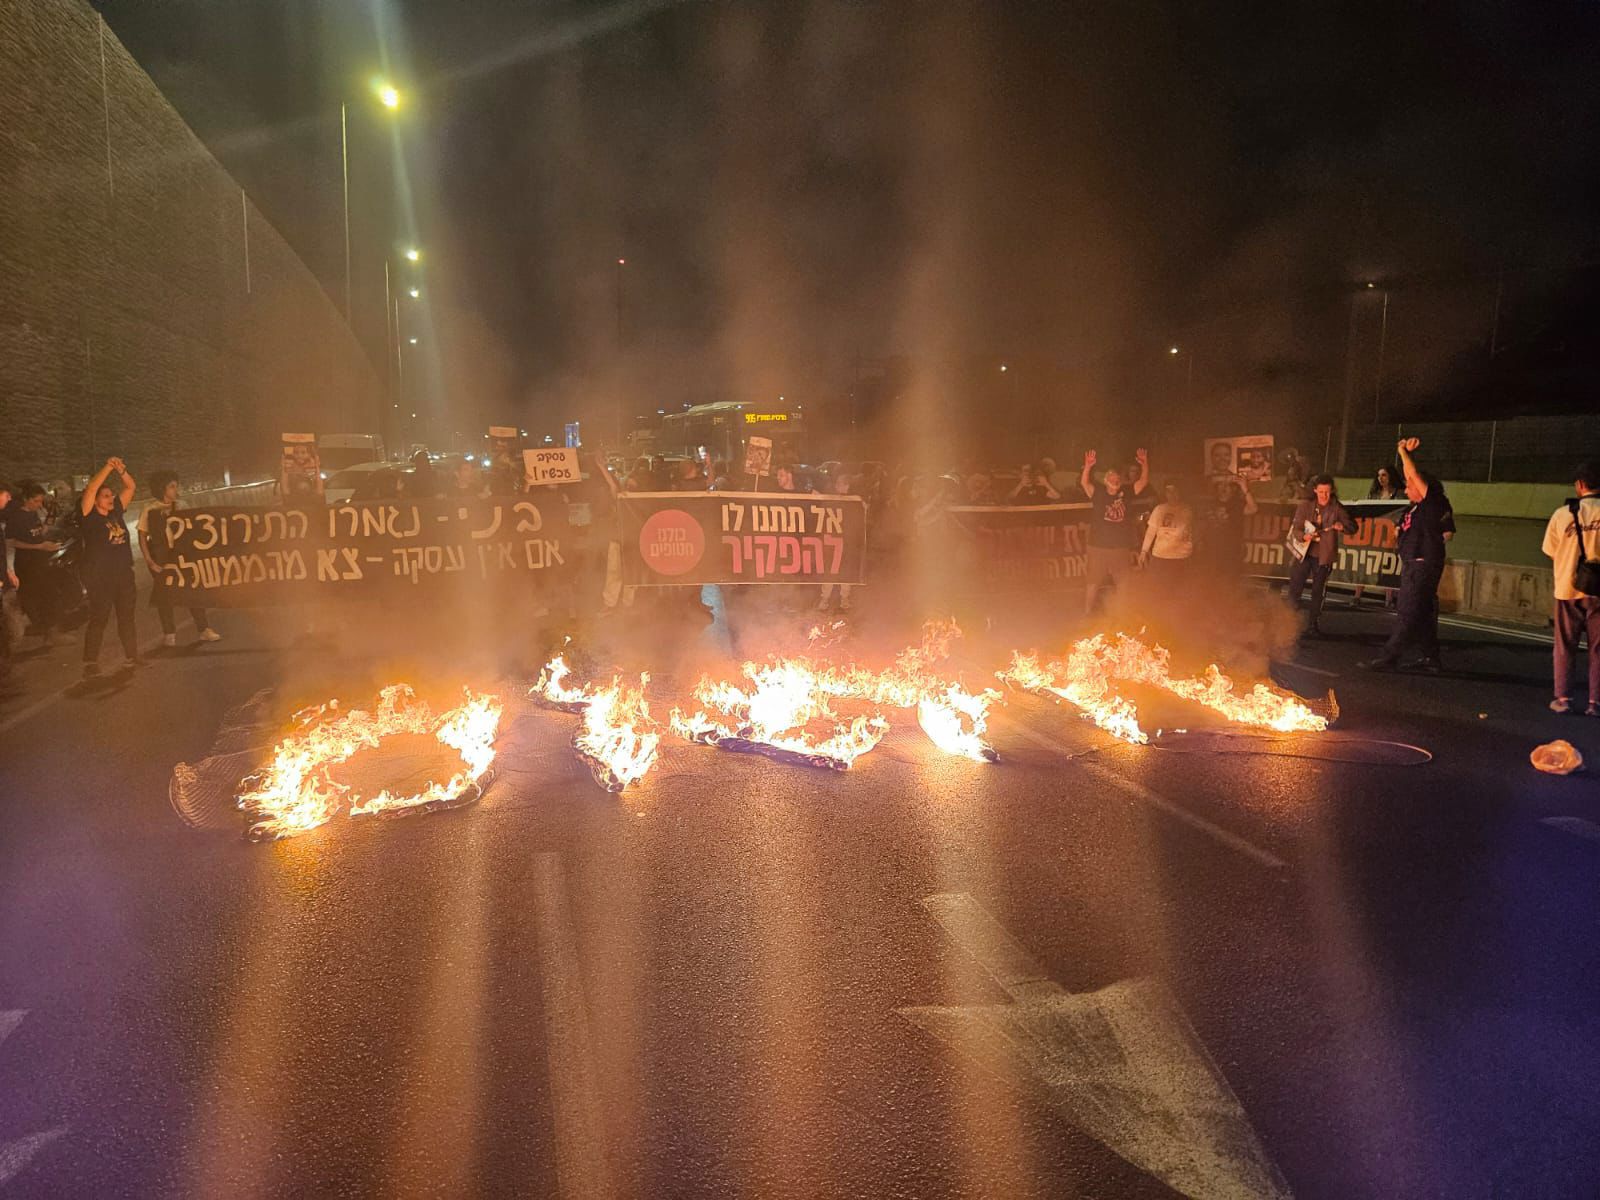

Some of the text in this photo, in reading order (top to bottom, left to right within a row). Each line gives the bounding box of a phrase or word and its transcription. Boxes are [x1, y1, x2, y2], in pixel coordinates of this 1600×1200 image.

[536, 452, 566, 463] עסקה
[328, 506, 421, 538] נגמרו
[721, 502, 843, 533] אל תתנו לו
[650, 543, 694, 557] חטופים
[657, 527, 686, 542] כולנו
[163, 549, 307, 589] מהממשלה
[392, 545, 465, 584] עסקה
[477, 541, 517, 580] אין
[525, 538, 565, 569] אם
[721, 534, 843, 578] להפקיר
